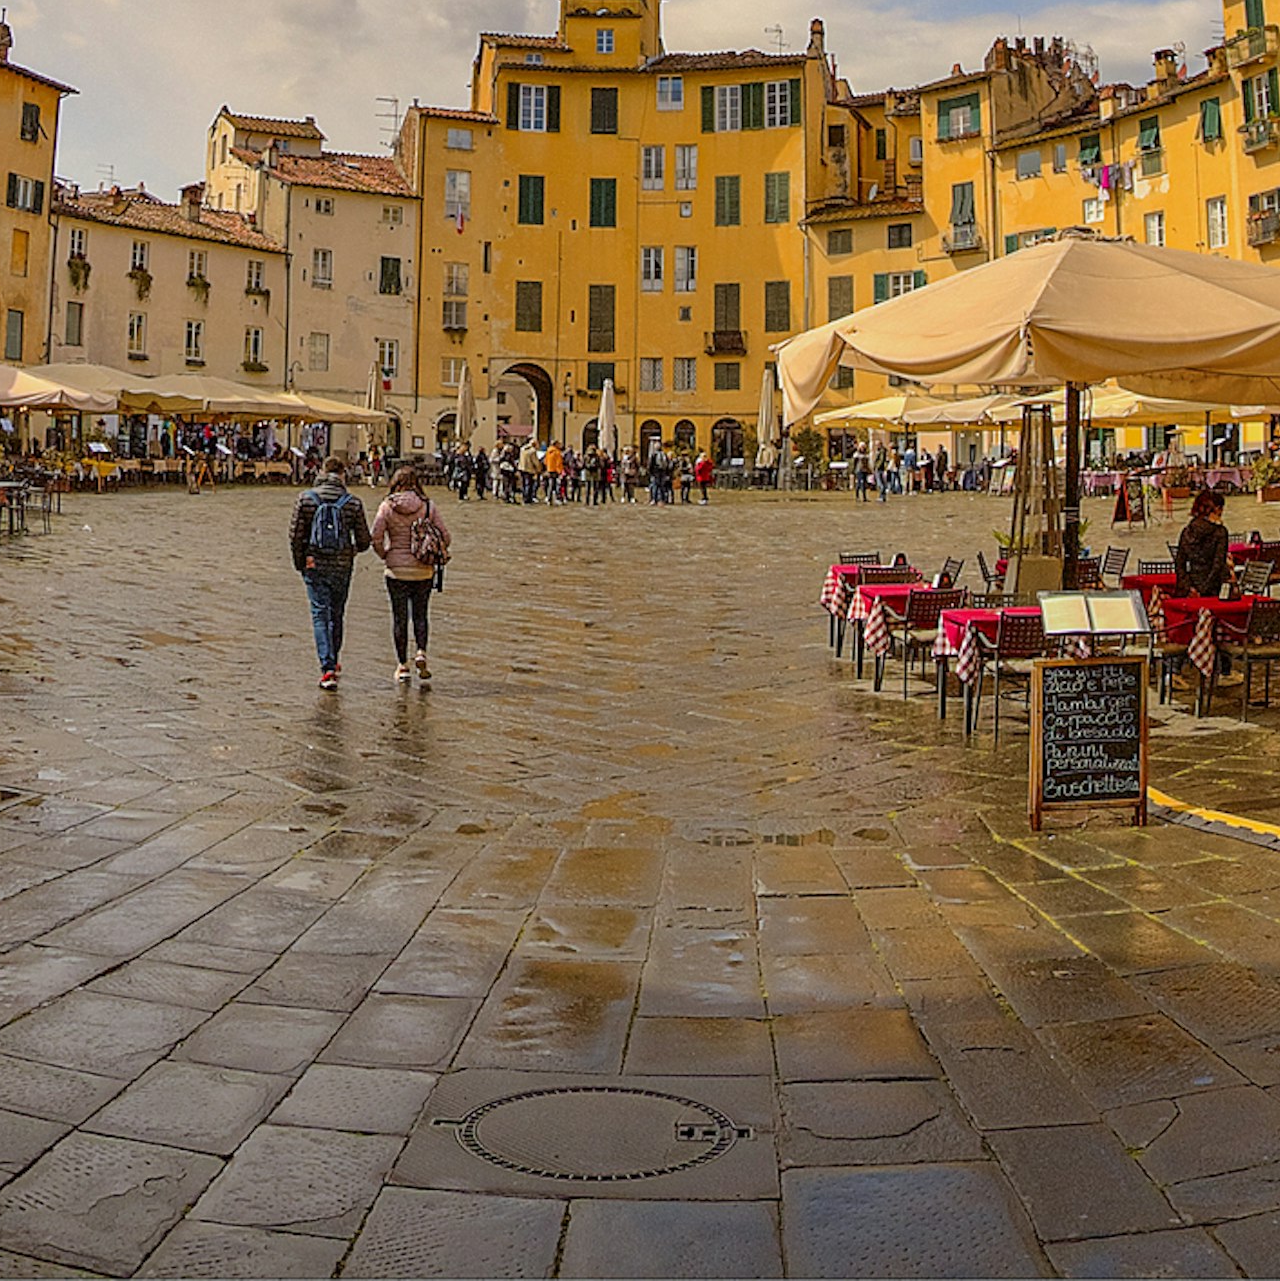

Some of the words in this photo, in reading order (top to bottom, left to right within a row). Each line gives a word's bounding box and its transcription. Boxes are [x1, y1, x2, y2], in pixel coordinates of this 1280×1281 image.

[1086, 679, 1098, 691] e
[1101, 675, 1136, 692] pepe
[1044, 693, 1137, 714] Hamburger
[1044, 712, 1135, 730] Carpaccio
[1044, 726, 1065, 741] di
[1045, 742, 1105, 759] Panini
